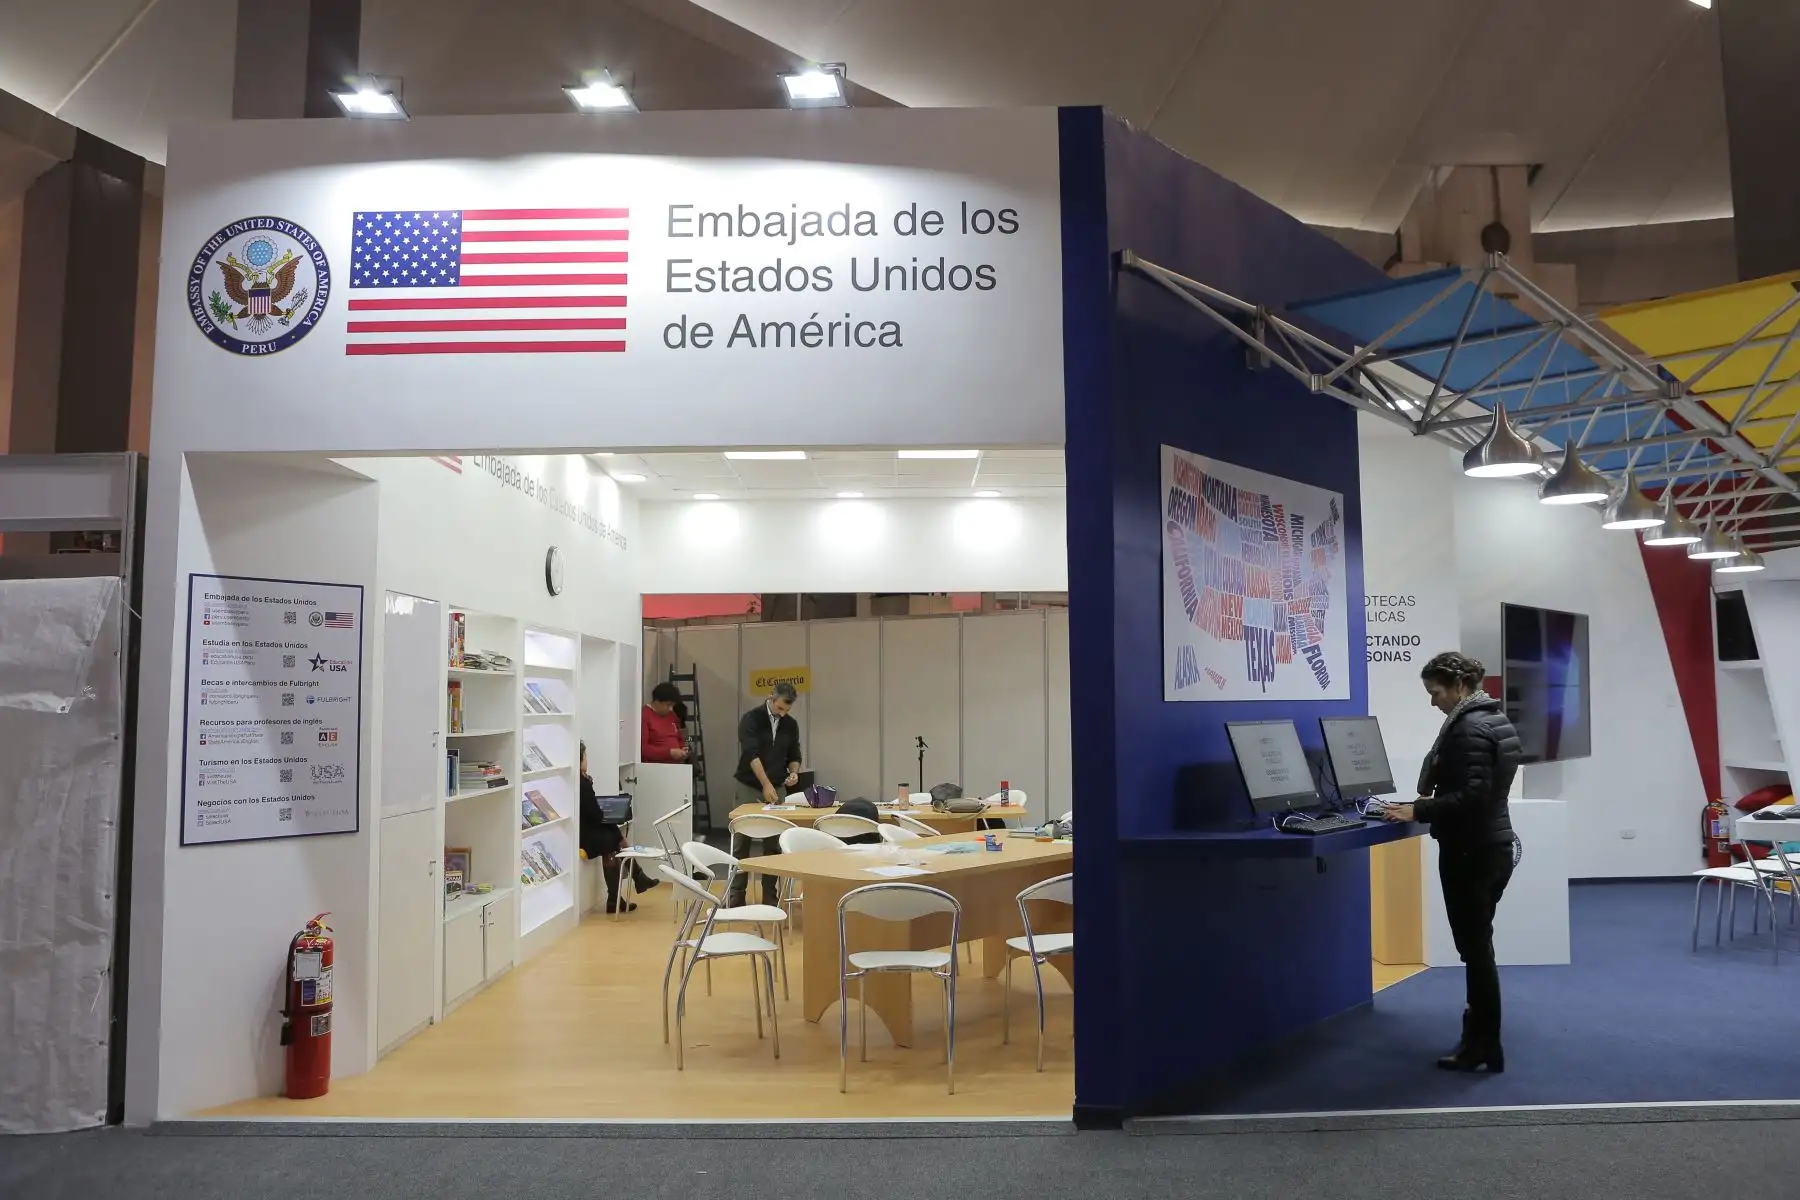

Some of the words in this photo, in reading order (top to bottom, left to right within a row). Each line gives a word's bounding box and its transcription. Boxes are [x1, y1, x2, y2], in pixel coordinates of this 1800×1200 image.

[226, 218, 275, 237] UNITED
[276, 220, 318, 251] STATES
[668, 203, 878, 246] Embajada
[893, 202, 945, 236] de
[961, 201, 1020, 235] los
[202, 233, 226, 257] THE
[193, 256, 208, 275] OF
[312, 250, 327, 269] OF
[666, 257, 834, 293] Estados
[851, 256, 998, 292] Unidos
[190, 276, 215, 334] EMBASSY
[303, 270, 330, 327] AMERICA
[663, 314, 714, 349] de
[726, 312, 903, 348] América
[241, 341, 277, 354] PERU
[524, 473, 535, 498] de
[536, 478, 548, 506] los
[1202, 473, 1238, 523] MONTANA
[1168, 486, 1198, 532] OREGON
[1239, 517, 1262, 532] SOUTH
[1167, 521, 1198, 622] CALIFORNIA
[204, 592, 240, 602] Embajada
[251, 595, 263, 603] los
[264, 596, 292, 605] Estados
[293, 598, 317, 606] Unidos
[1220, 595, 1244, 619] NEW
[1367, 610, 1406, 622] LICAS
[1220, 616, 1244, 642] MEXICO
[202, 639, 230, 647] Estudia
[254, 640, 283, 648] Estados
[284, 641, 308, 649] Unidos
[329, 664, 347, 672] USA
[1174, 645, 1201, 690] ALASKA
[1244, 625, 1275, 693] TEXAS
[1301, 643, 1331, 692] FLORIDA
[231, 679, 278, 687] intercambios
[289, 680, 319, 688] Fulbright
[755, 677, 765, 688] El
[254, 718, 291, 726] profesores
[319, 732, 328, 741] A
[329, 732, 338, 741] E
[253, 757, 282, 765] Estados
[197, 799, 232, 807] Negocios
[291, 794, 315, 802] Unidos
